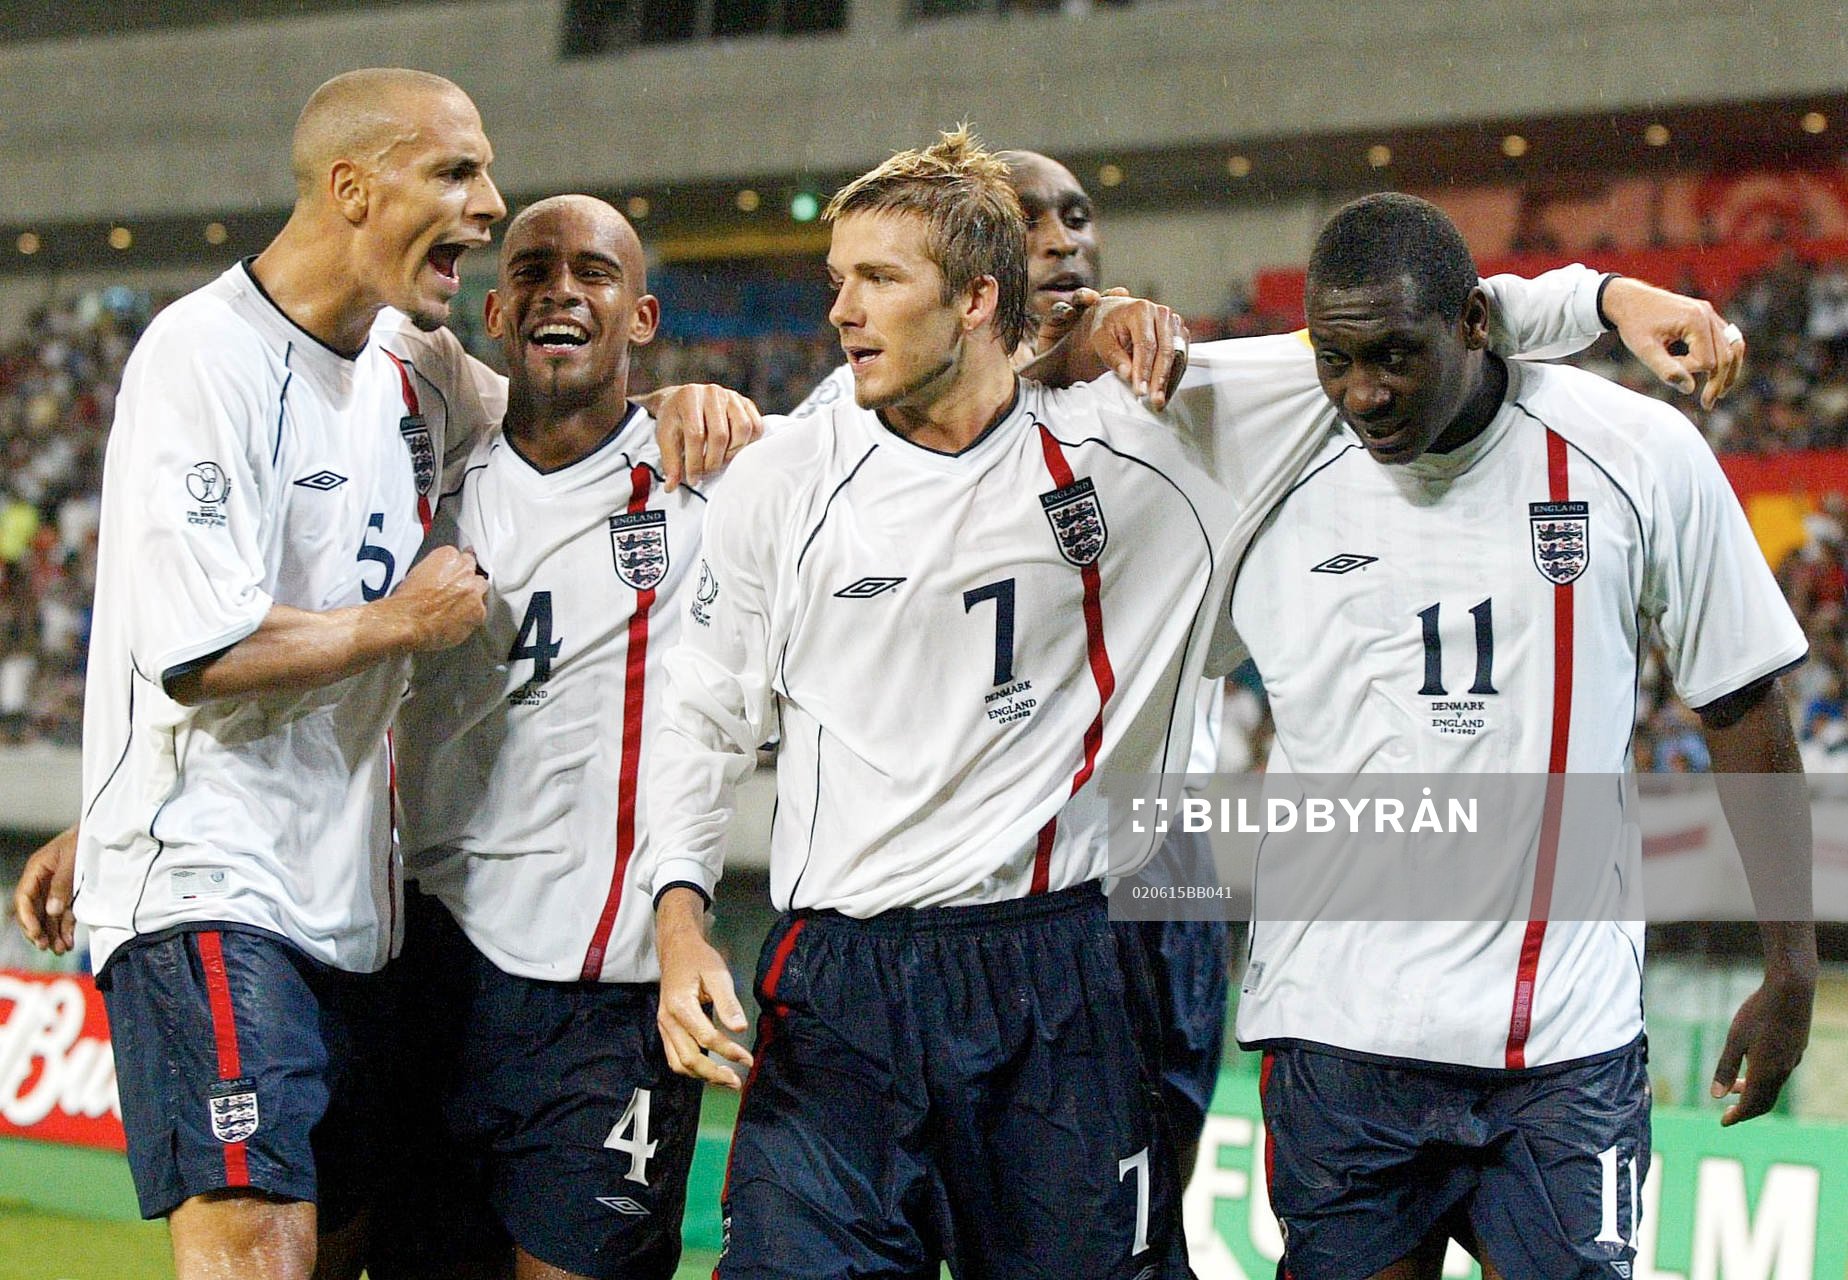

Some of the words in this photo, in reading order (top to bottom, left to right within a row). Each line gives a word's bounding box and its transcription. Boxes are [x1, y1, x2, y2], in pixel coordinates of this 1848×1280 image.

[613, 512, 662, 526] ENGLAND
[1044, 482, 1090, 504] ENGLAND
[1534, 504, 1585, 513] ENGLAND
[356, 513, 395, 602] 5
[507, 591, 563, 683] 4
[963, 577, 1016, 687] 7
[1416, 597, 1499, 696] 11
[984, 680, 1032, 703] DENMARK
[988, 699, 1037, 719] ENGLAND
[1431, 702, 1485, 711] DENMARK
[1432, 719, 1485, 728] ENGLAND
[603, 1087, 659, 1187] 4
[1118, 1146, 1150, 1257] 7
[1594, 1145, 1638, 1252] 11
